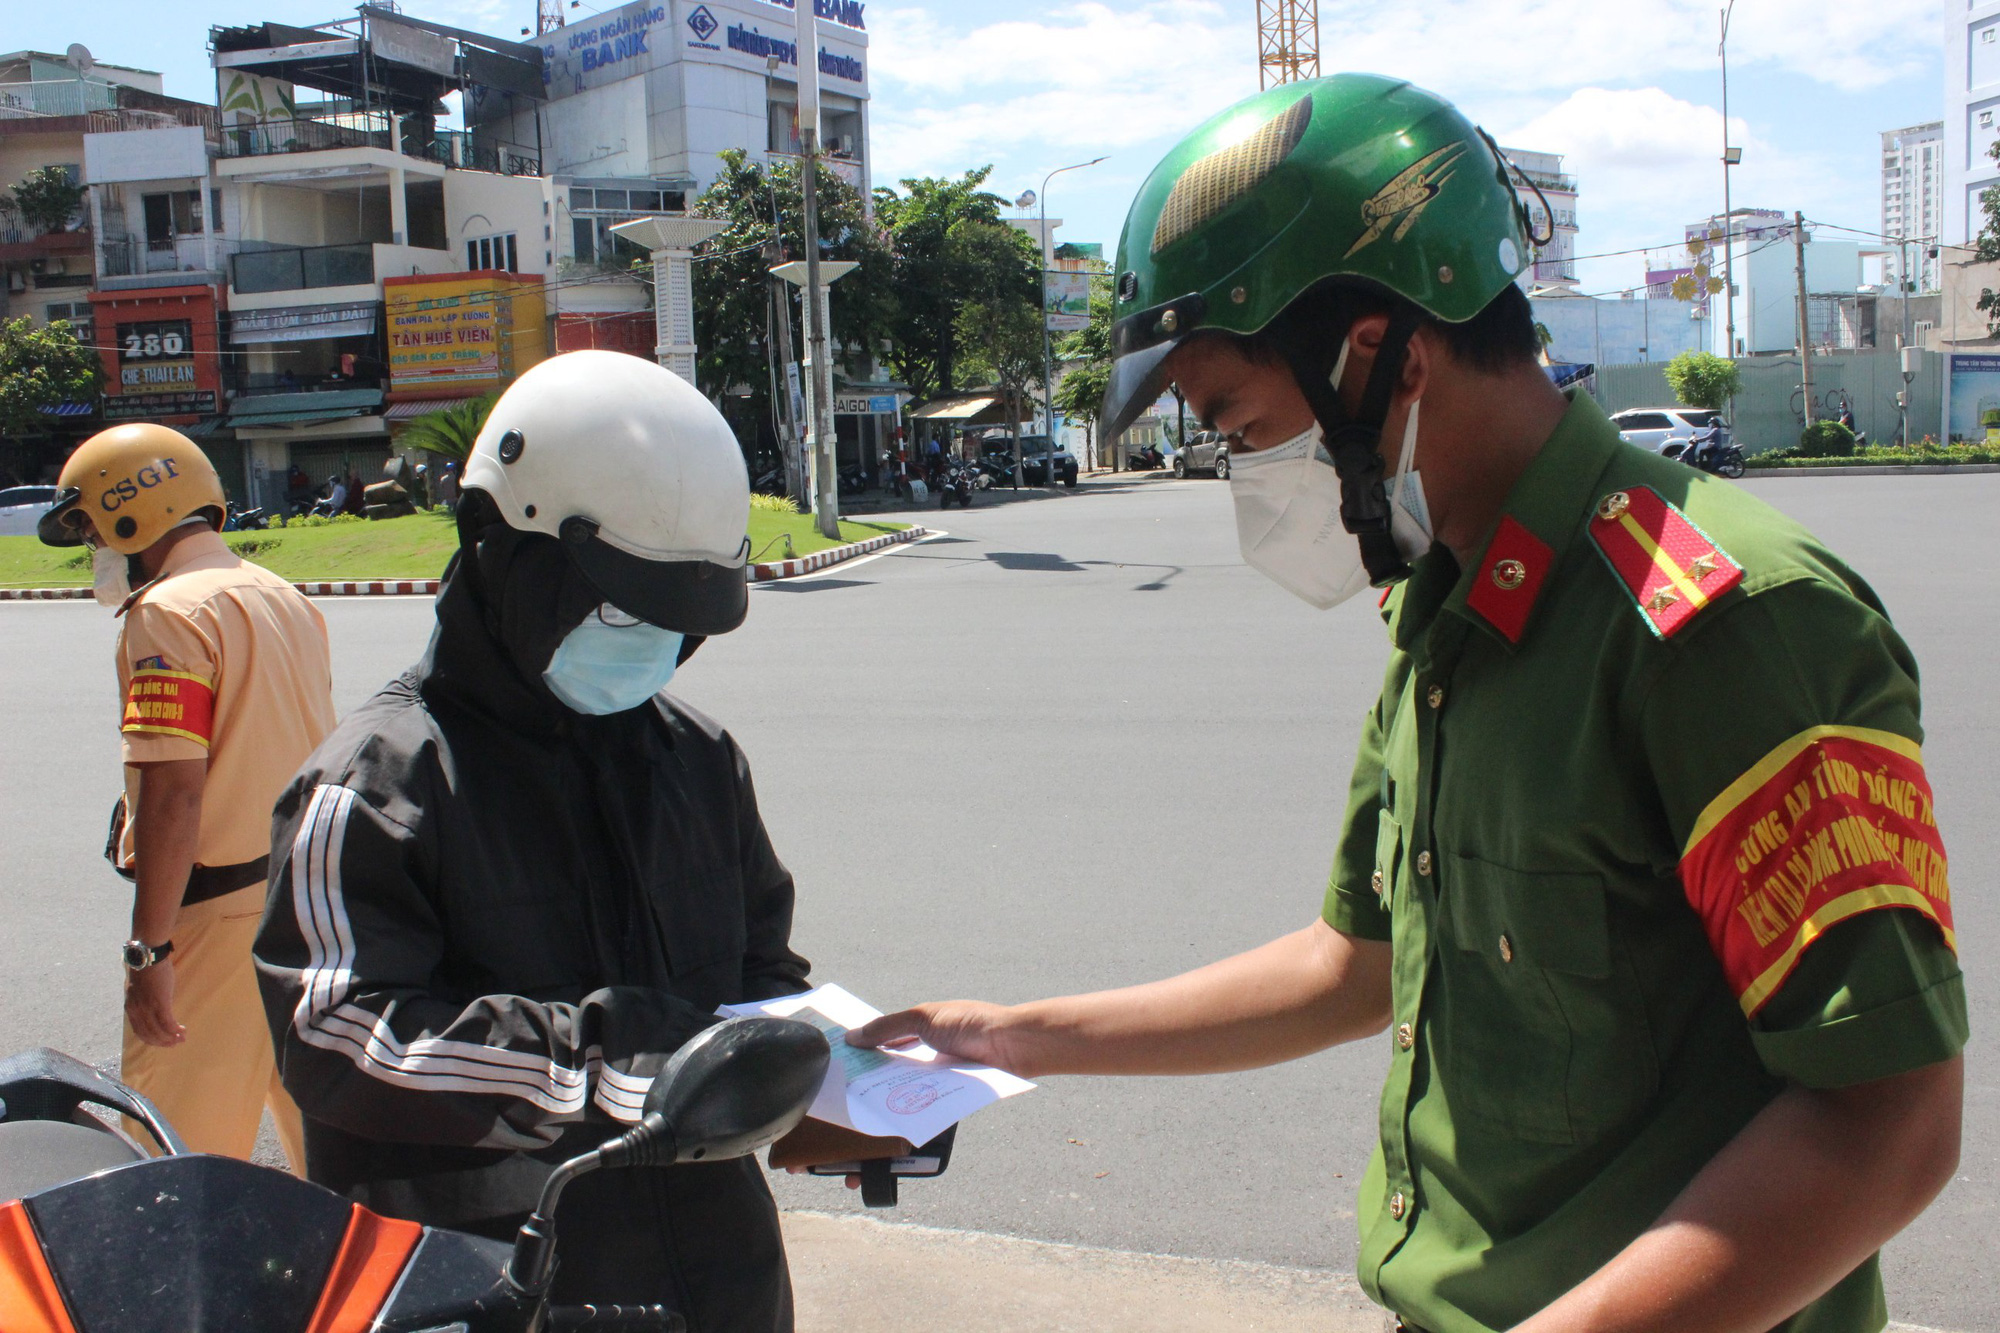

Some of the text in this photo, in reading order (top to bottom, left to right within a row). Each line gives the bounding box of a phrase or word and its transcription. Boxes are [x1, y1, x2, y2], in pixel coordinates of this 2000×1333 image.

[582, 29, 648, 72] BANK
[125, 332, 183, 358] 280
[101, 458, 179, 512] CSGT
[1735, 810, 1789, 874] CÔNG
[1784, 780, 1811, 827] AN
[1812, 750, 1859, 800] TỈNH
